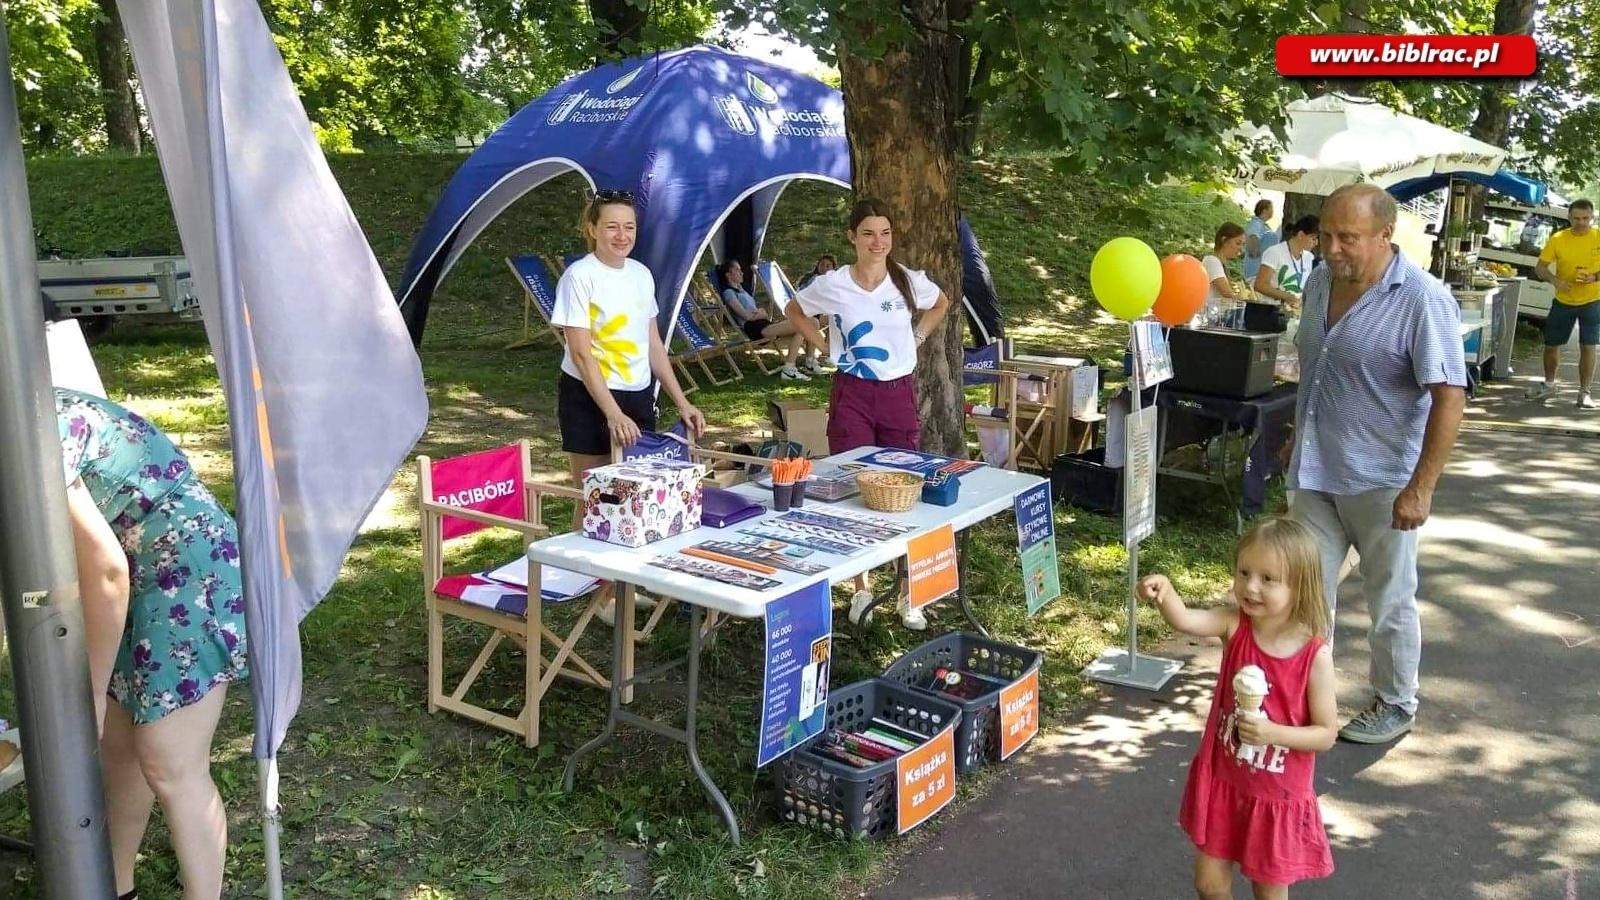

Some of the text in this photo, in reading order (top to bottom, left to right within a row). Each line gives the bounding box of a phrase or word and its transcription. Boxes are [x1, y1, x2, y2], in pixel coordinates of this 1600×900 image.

[569, 111, 629, 123] Raciborskie
[771, 122, 846, 138] aciborskie
[438, 478, 515, 508] RACIBÓRZ
[1005, 690, 1034, 714] Książka
[905, 751, 947, 786] Książka
[912, 791, 926, 808] za
[928, 781, 935, 797] 5
